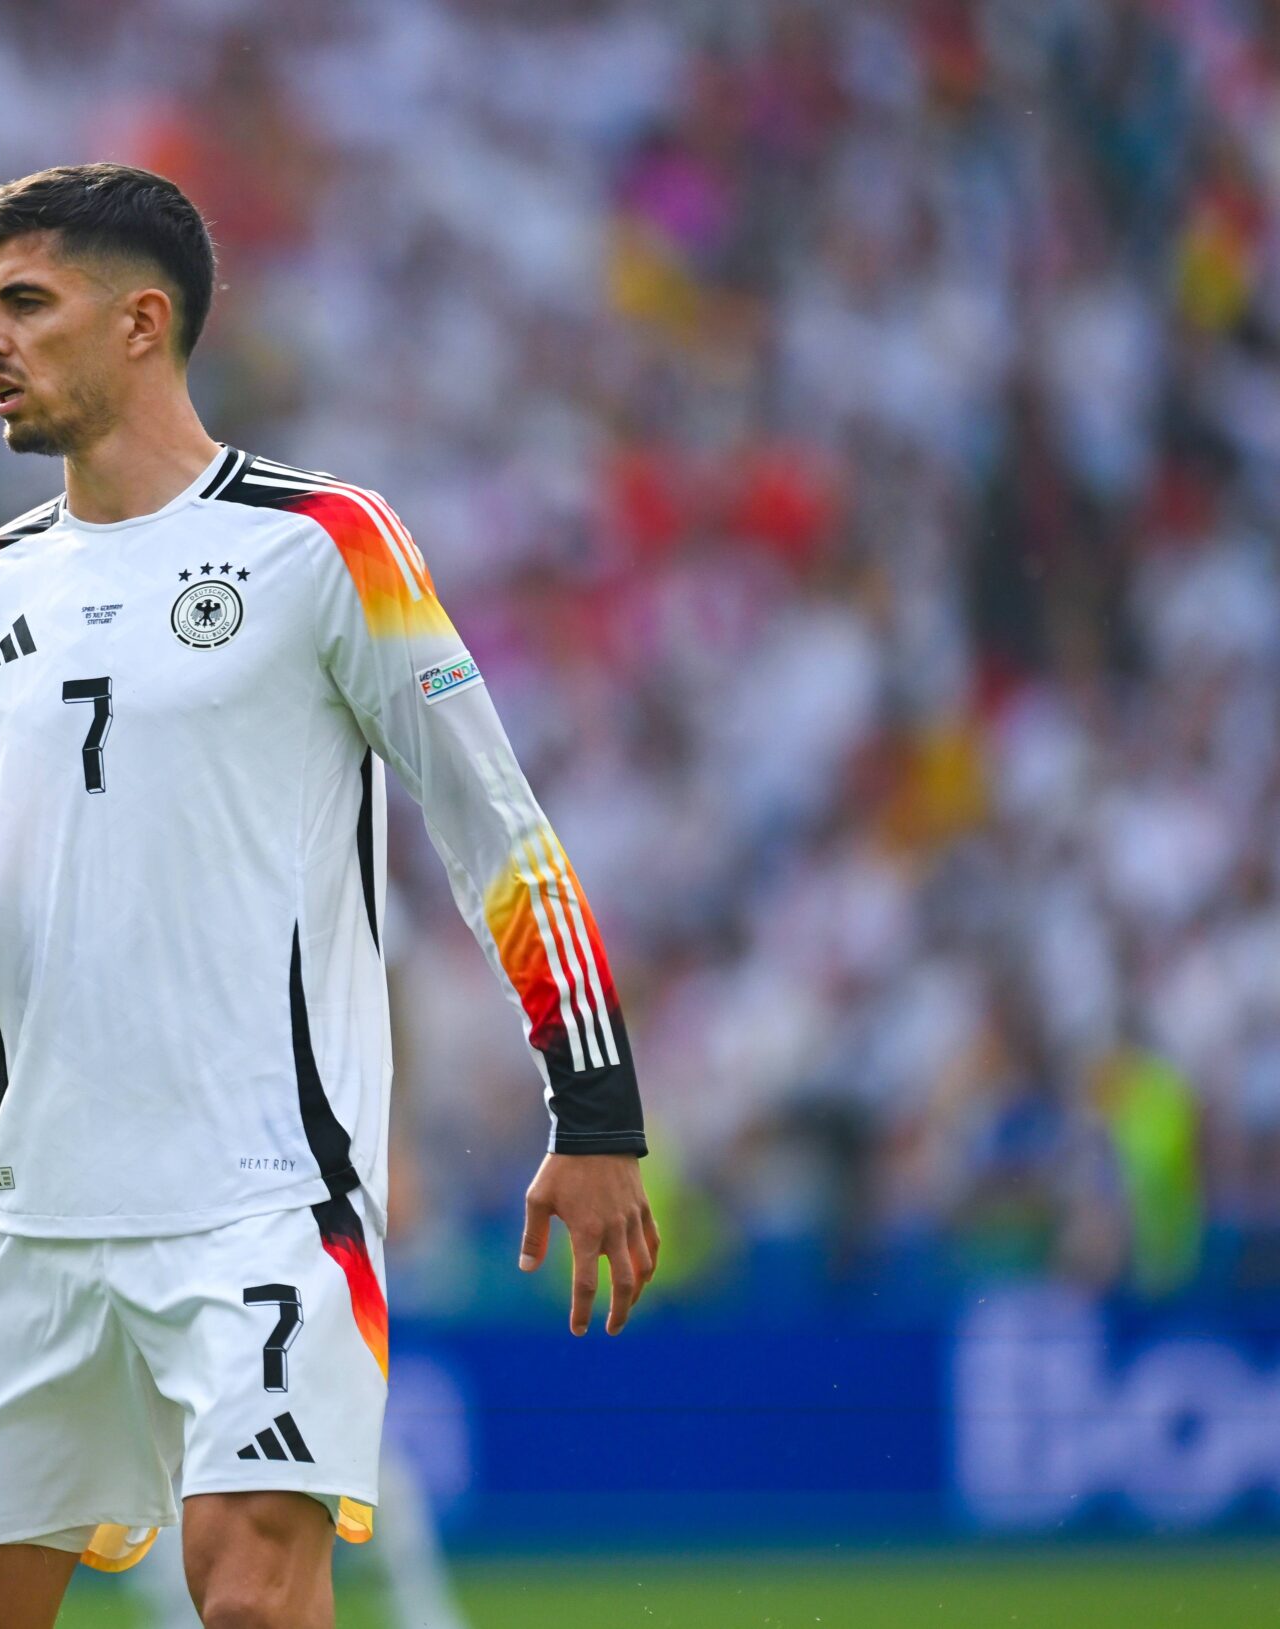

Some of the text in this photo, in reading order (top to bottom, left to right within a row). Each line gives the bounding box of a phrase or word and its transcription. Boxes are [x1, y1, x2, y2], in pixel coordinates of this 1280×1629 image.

[189, 588, 230, 601] DEUTSCHER
[181, 620, 230, 639] FUSSBALL-BUND
[419, 667, 441, 682] UEFA
[62, 676, 113, 794] 7
[243, 1283, 304, 1393] 7
